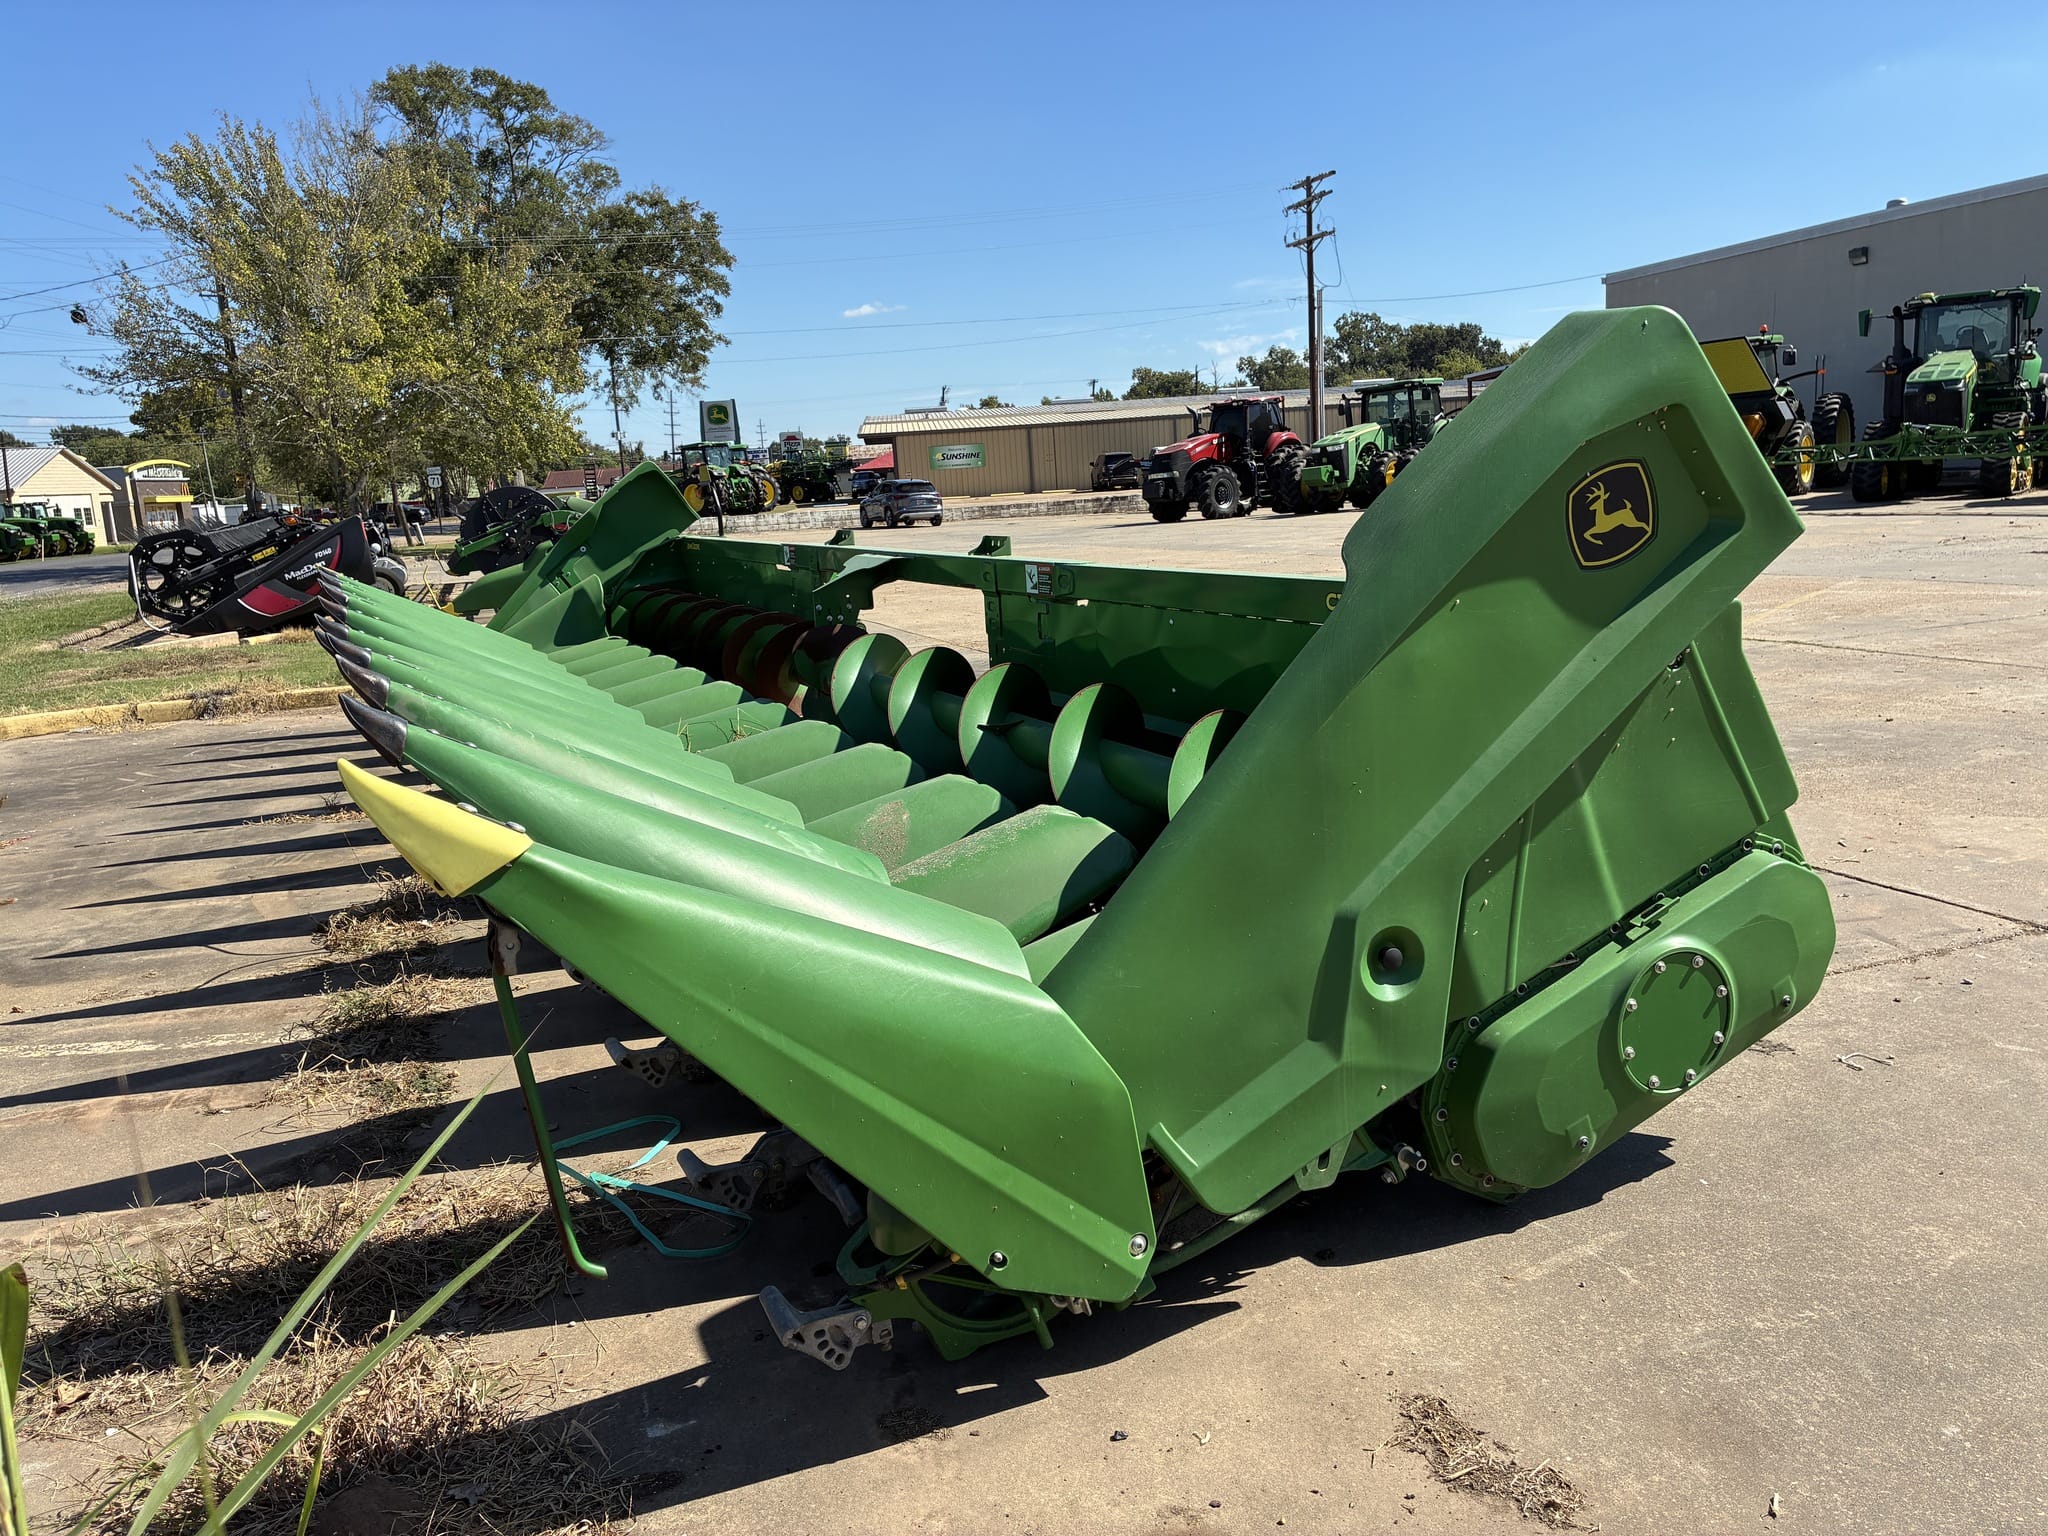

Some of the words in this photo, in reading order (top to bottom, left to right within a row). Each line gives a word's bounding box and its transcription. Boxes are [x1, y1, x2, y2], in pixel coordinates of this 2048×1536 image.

[940, 452, 982, 461] SUNSHINE
[430, 477, 440, 486] 71
[284, 560, 326, 581] MacDon
